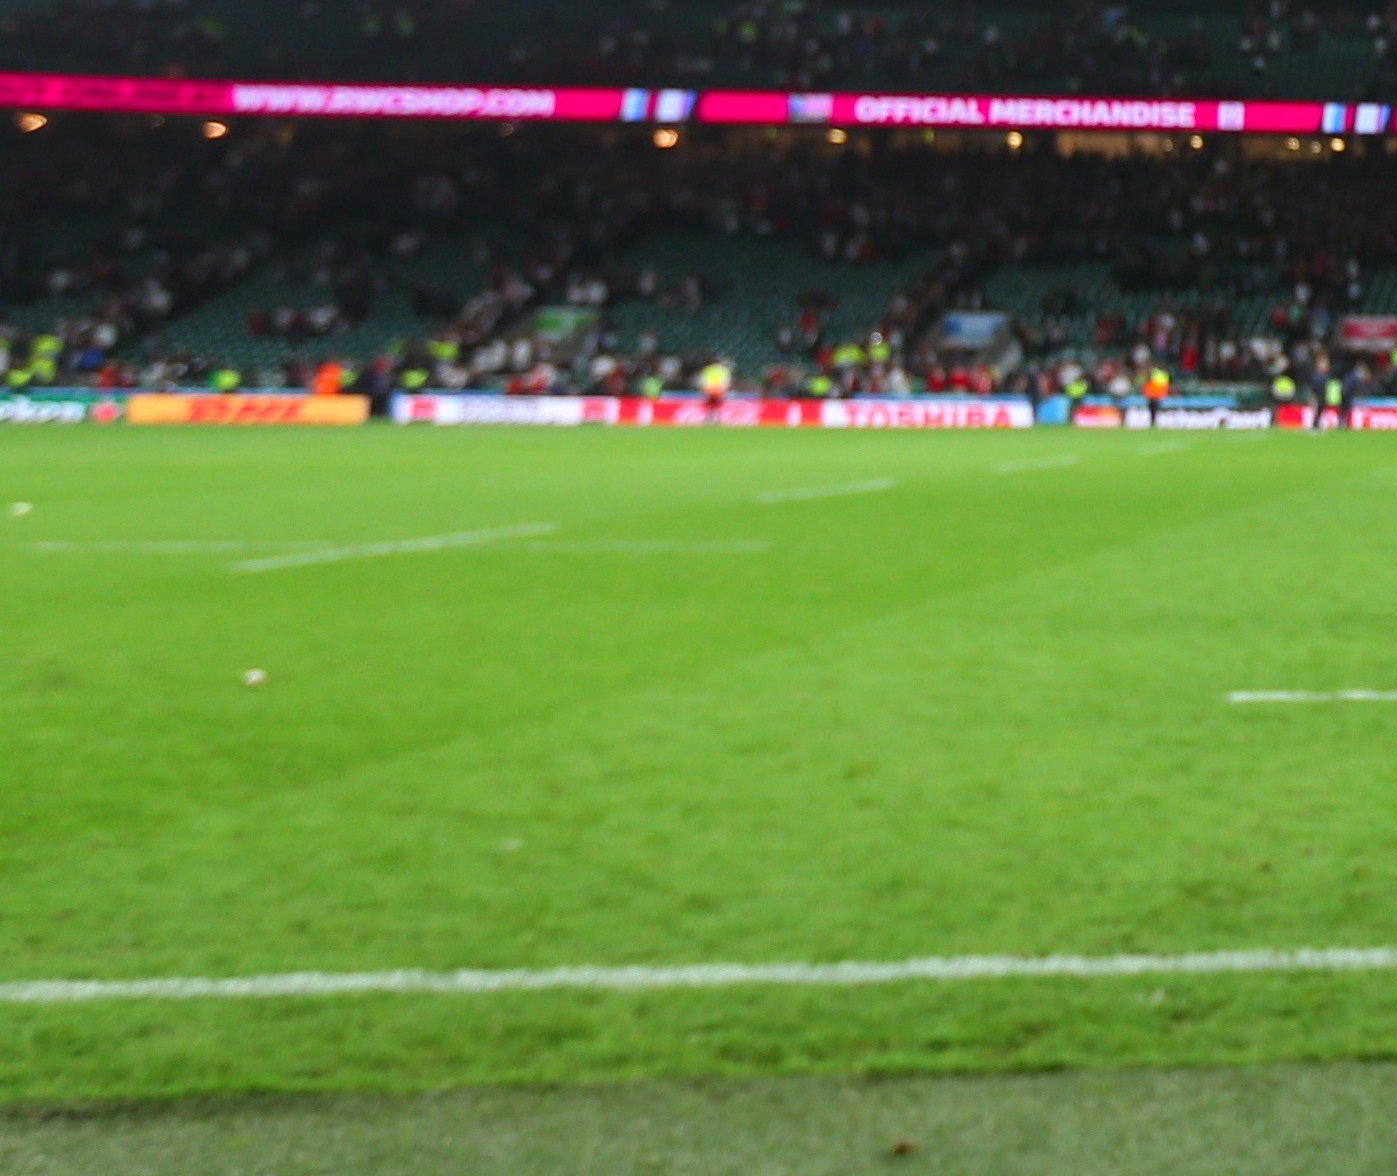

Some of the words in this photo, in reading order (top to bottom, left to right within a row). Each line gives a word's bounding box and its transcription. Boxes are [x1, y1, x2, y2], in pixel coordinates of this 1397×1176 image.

[232, 84, 556, 117] WWW.RWCSHOP.COM
[853, 96, 984, 123] OFFICIAL
[988, 98, 1196, 128] MERCHANDISE
[845, 402, 1014, 427] TOSHIBA
